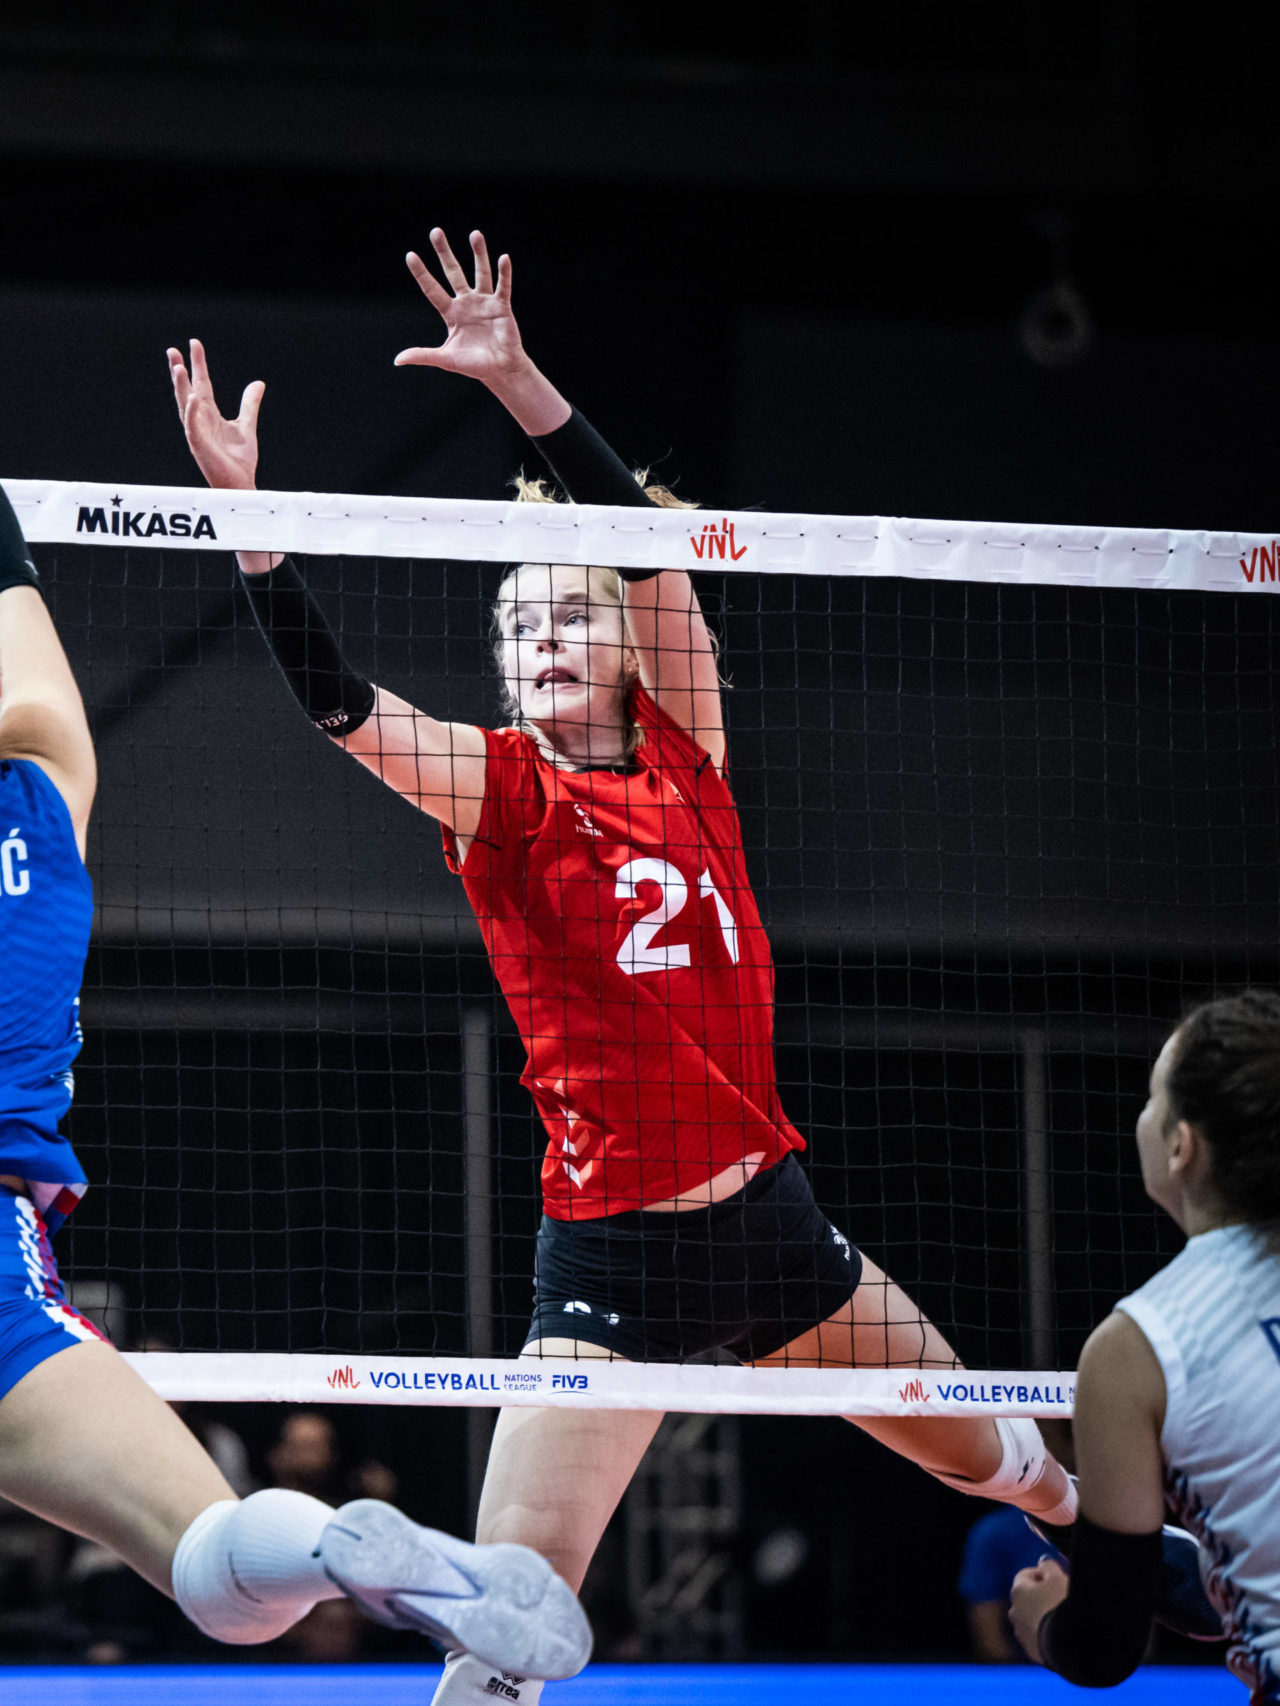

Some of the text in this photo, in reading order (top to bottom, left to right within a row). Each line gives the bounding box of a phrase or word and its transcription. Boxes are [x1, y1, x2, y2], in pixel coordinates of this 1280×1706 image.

[76, 504, 218, 540] MIKASA
[690, 517, 748, 561] VNL
[1239, 540, 1280, 583] VN
[614, 857, 740, 976] 21
[327, 1365, 501, 1391] VNL VOLLEYBALL
[504, 1373, 542, 1383] NATIONS
[504, 1383, 537, 1392] LEAGUE
[552, 1374, 589, 1390] FIVB
[898, 1378, 1066, 1404] VNL VOLLEYBALL
